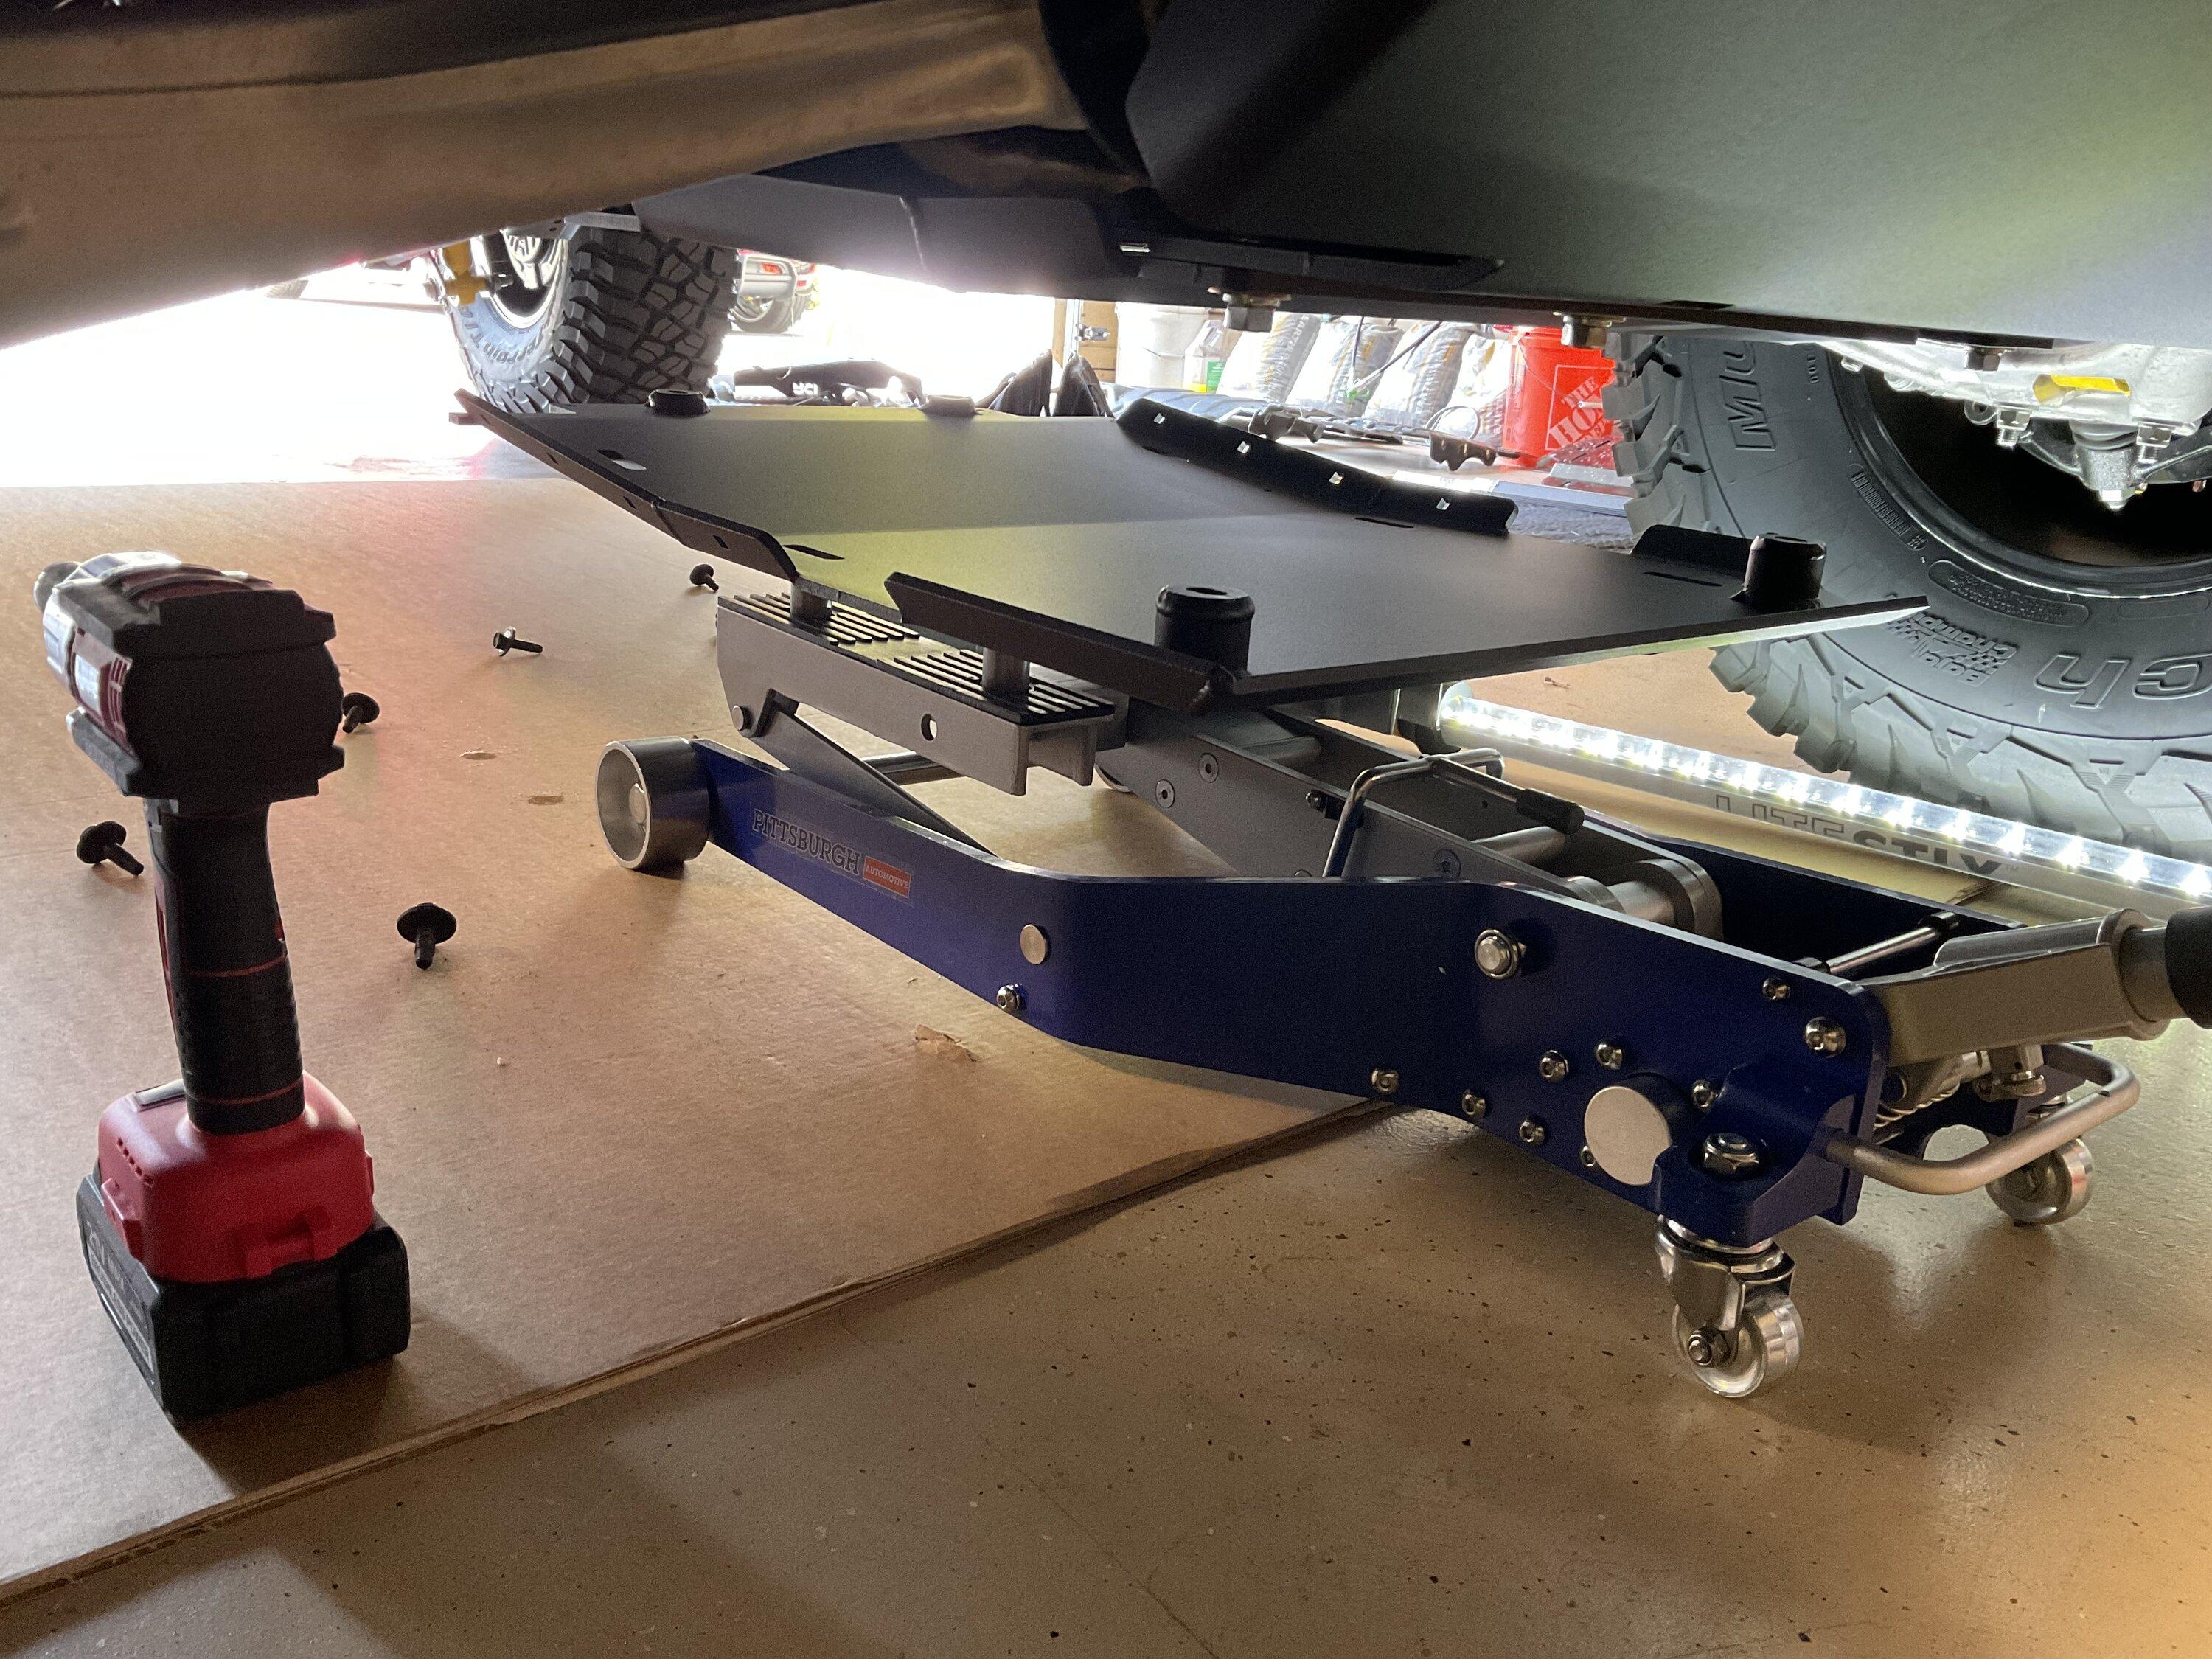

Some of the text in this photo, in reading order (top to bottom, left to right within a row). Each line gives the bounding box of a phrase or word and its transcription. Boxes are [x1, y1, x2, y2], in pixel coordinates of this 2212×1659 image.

[1561, 376, 1599, 409] THE
[1550, 393, 1604, 448] HO
[1914, 612, 2019, 660] Champi
[752, 809, 910, 889] PITTSBURGH AUTOMOTIVE
